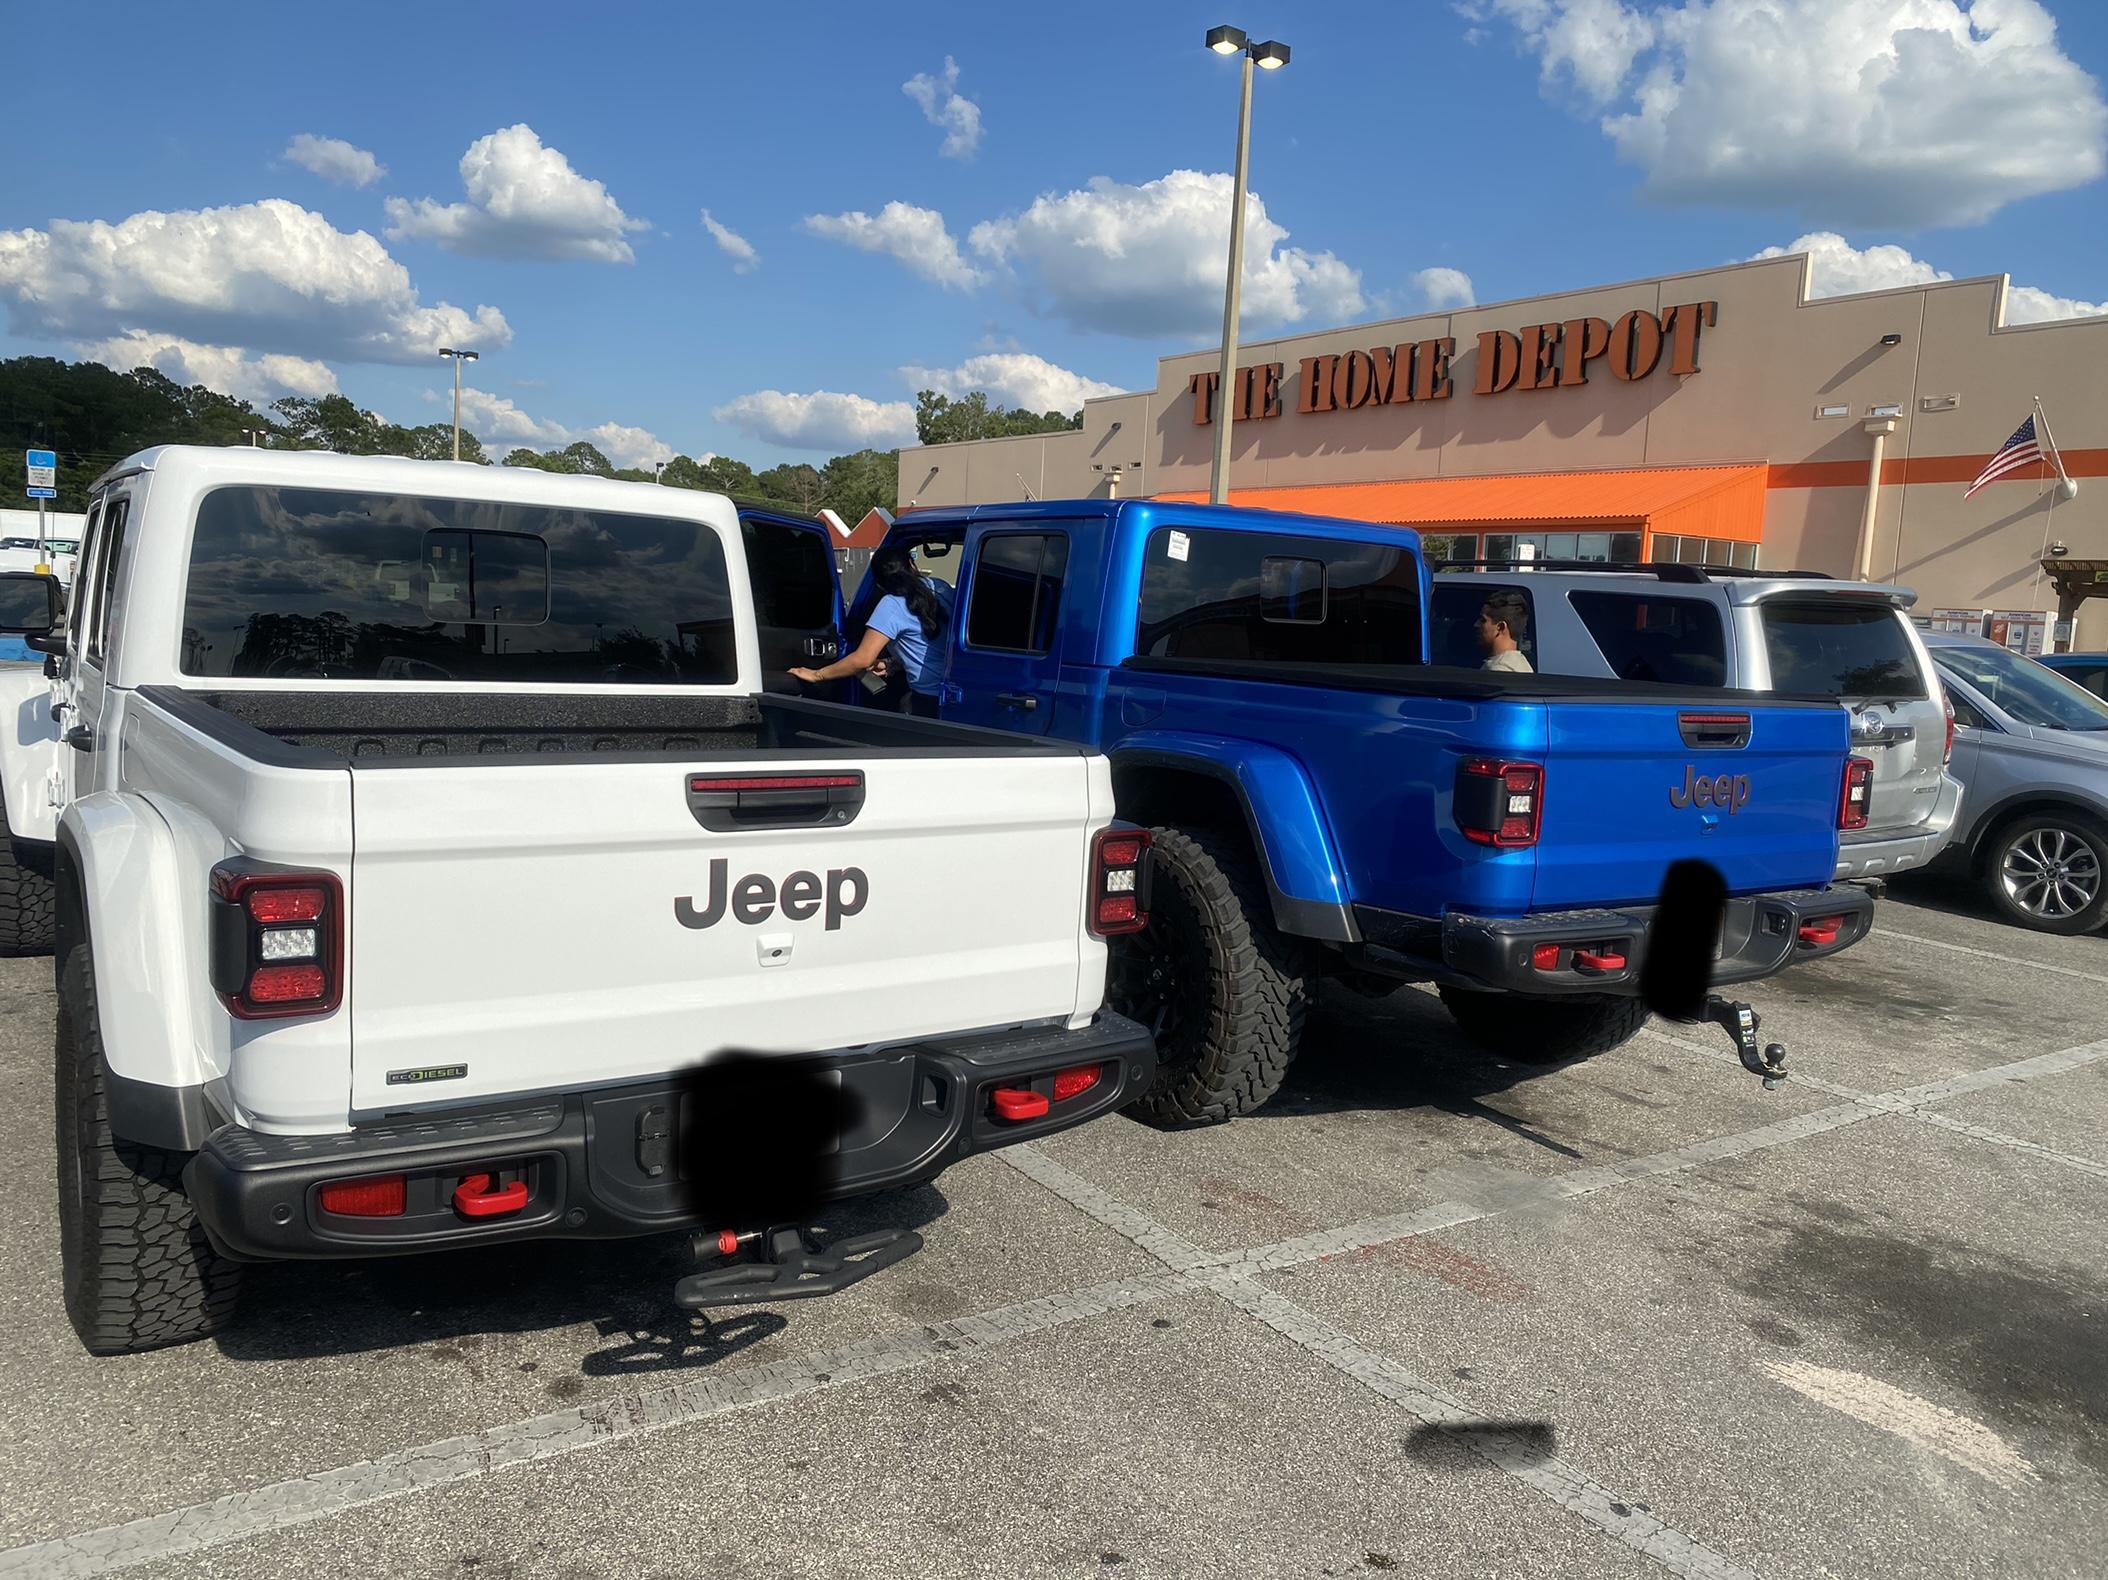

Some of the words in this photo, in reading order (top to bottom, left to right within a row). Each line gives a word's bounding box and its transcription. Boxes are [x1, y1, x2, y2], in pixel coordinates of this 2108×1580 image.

[1296, 337, 1456, 414] HOME
[1472, 300, 1718, 397] DEPOT
[1669, 764, 1751, 815] Jeep
[674, 858, 869, 931] Jeep
